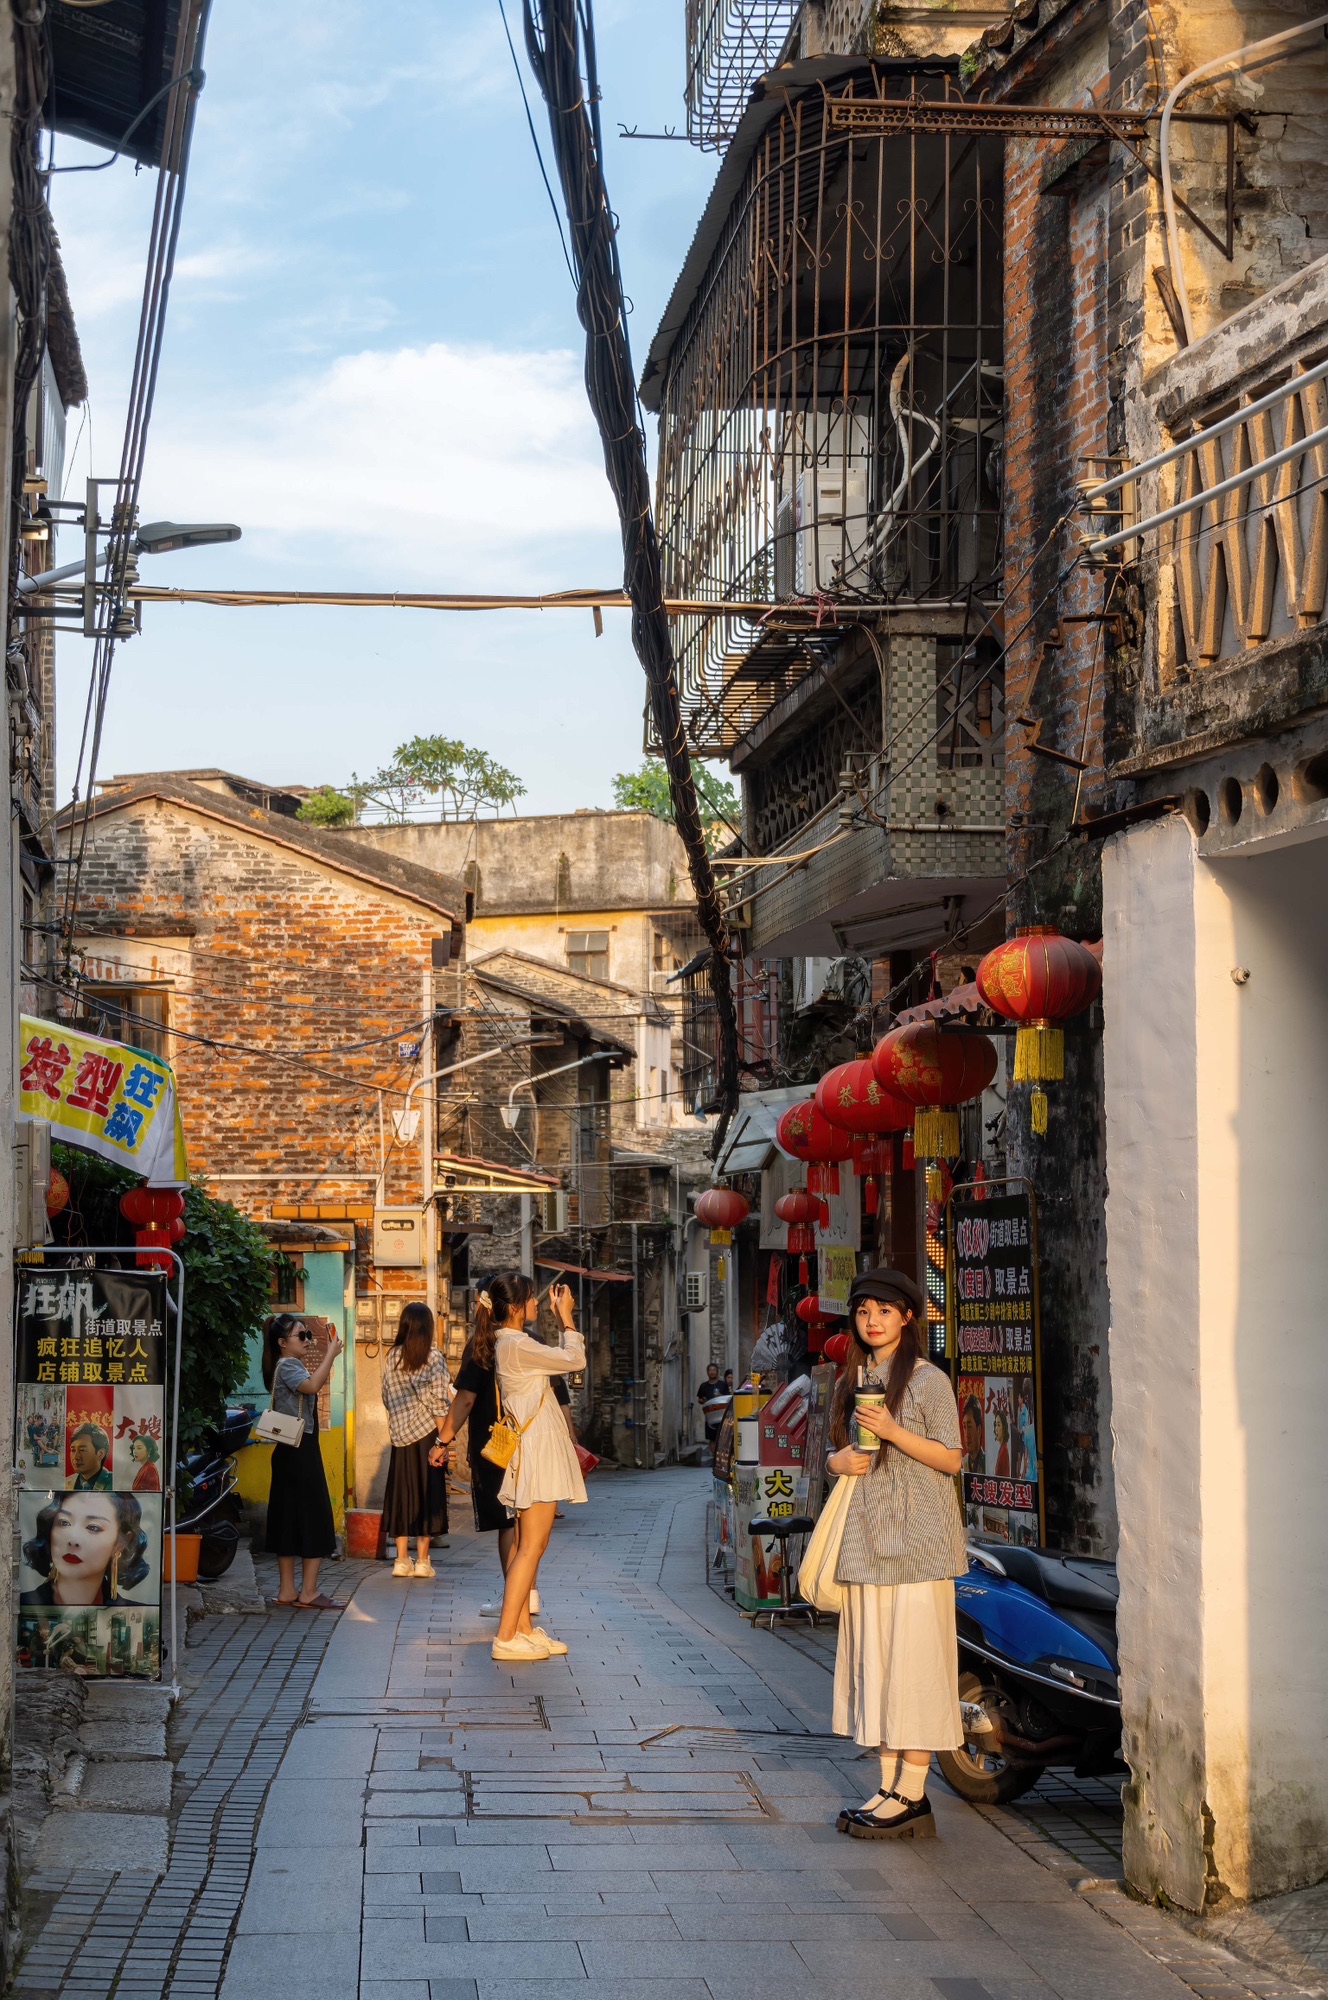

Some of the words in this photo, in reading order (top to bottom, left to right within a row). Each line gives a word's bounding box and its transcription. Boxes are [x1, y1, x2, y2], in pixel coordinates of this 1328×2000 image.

[20, 1036, 124, 1118] 发型
[994, 1265, 1030, 1295] 取景点
[85, 1319, 163, 1337] 街道取景点
[1005, 1326, 1032, 1352] 取景点
[37, 1337, 148, 1358] 疯狂追忆人
[37, 1361, 148, 1383] 店铺取景点
[115, 1415, 162, 1440] 大嫂
[970, 1477, 1033, 1508] 大嫂发型
